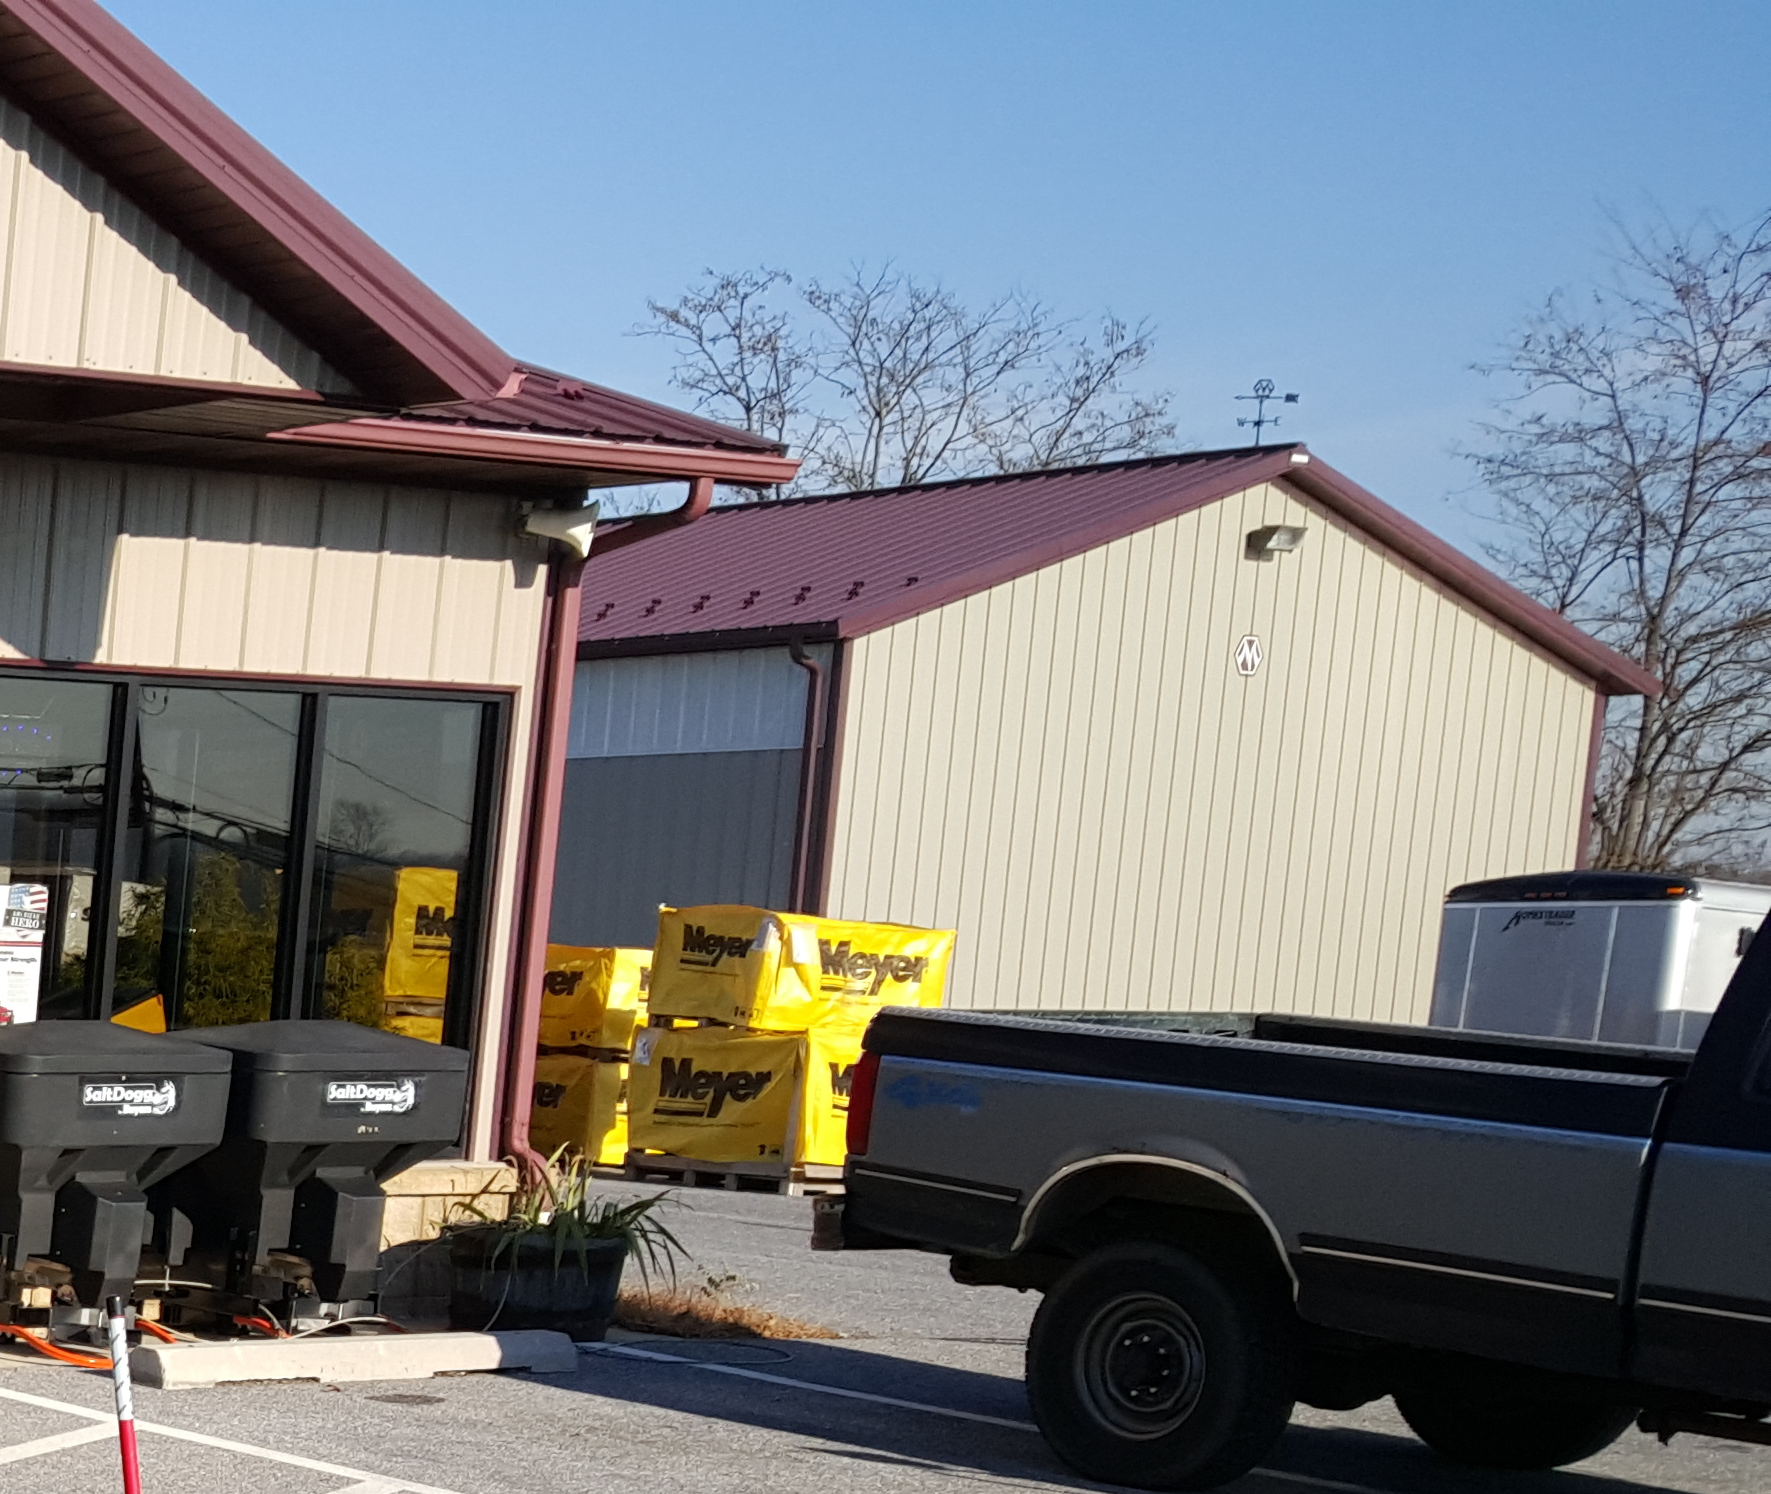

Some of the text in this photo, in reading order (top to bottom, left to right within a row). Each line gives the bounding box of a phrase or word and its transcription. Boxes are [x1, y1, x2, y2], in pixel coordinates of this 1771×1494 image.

[11, 917, 40, 929] HERO
[681, 923, 757, 967] Meyer
[818, 938, 929, 996] Meyer
[84, 1086, 157, 1103] SaltDogg
[329, 1084, 397, 1100] SaltDogg
[659, 1057, 772, 1118] Meyer
